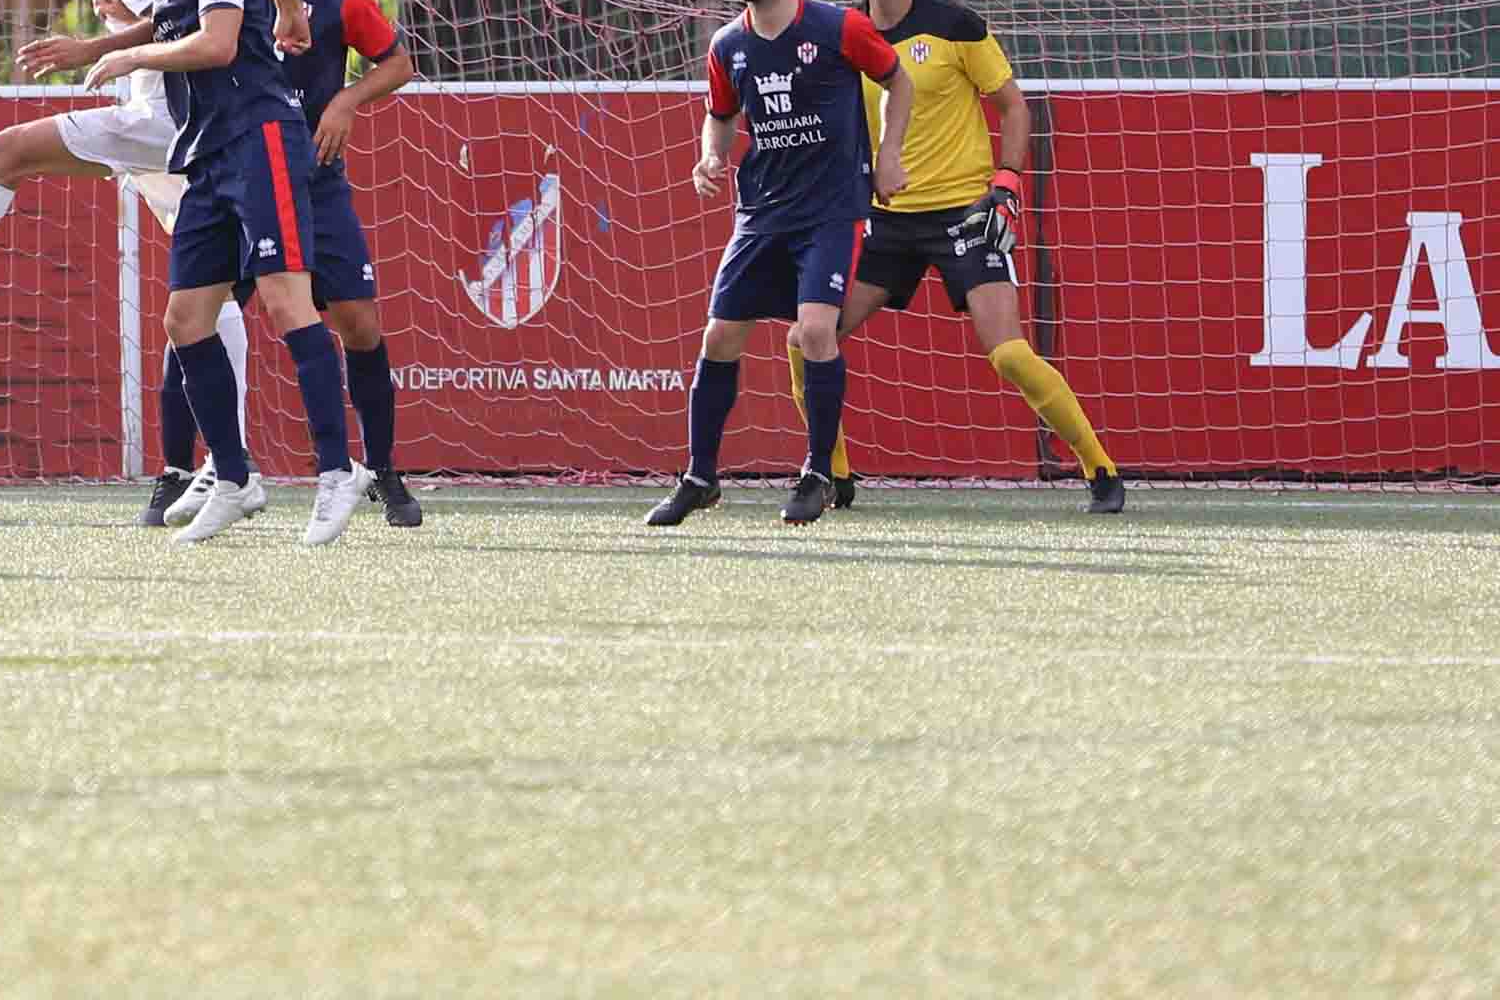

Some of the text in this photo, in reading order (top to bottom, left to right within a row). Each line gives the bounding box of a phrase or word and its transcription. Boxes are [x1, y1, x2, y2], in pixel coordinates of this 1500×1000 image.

[763, 92, 792, 115] NB
[1249, 152, 1500, 370] LA
[409, 367, 526, 391] DEPORTIVA
[532, 367, 605, 392] SANTA
[609, 368, 685, 392] MARTA
